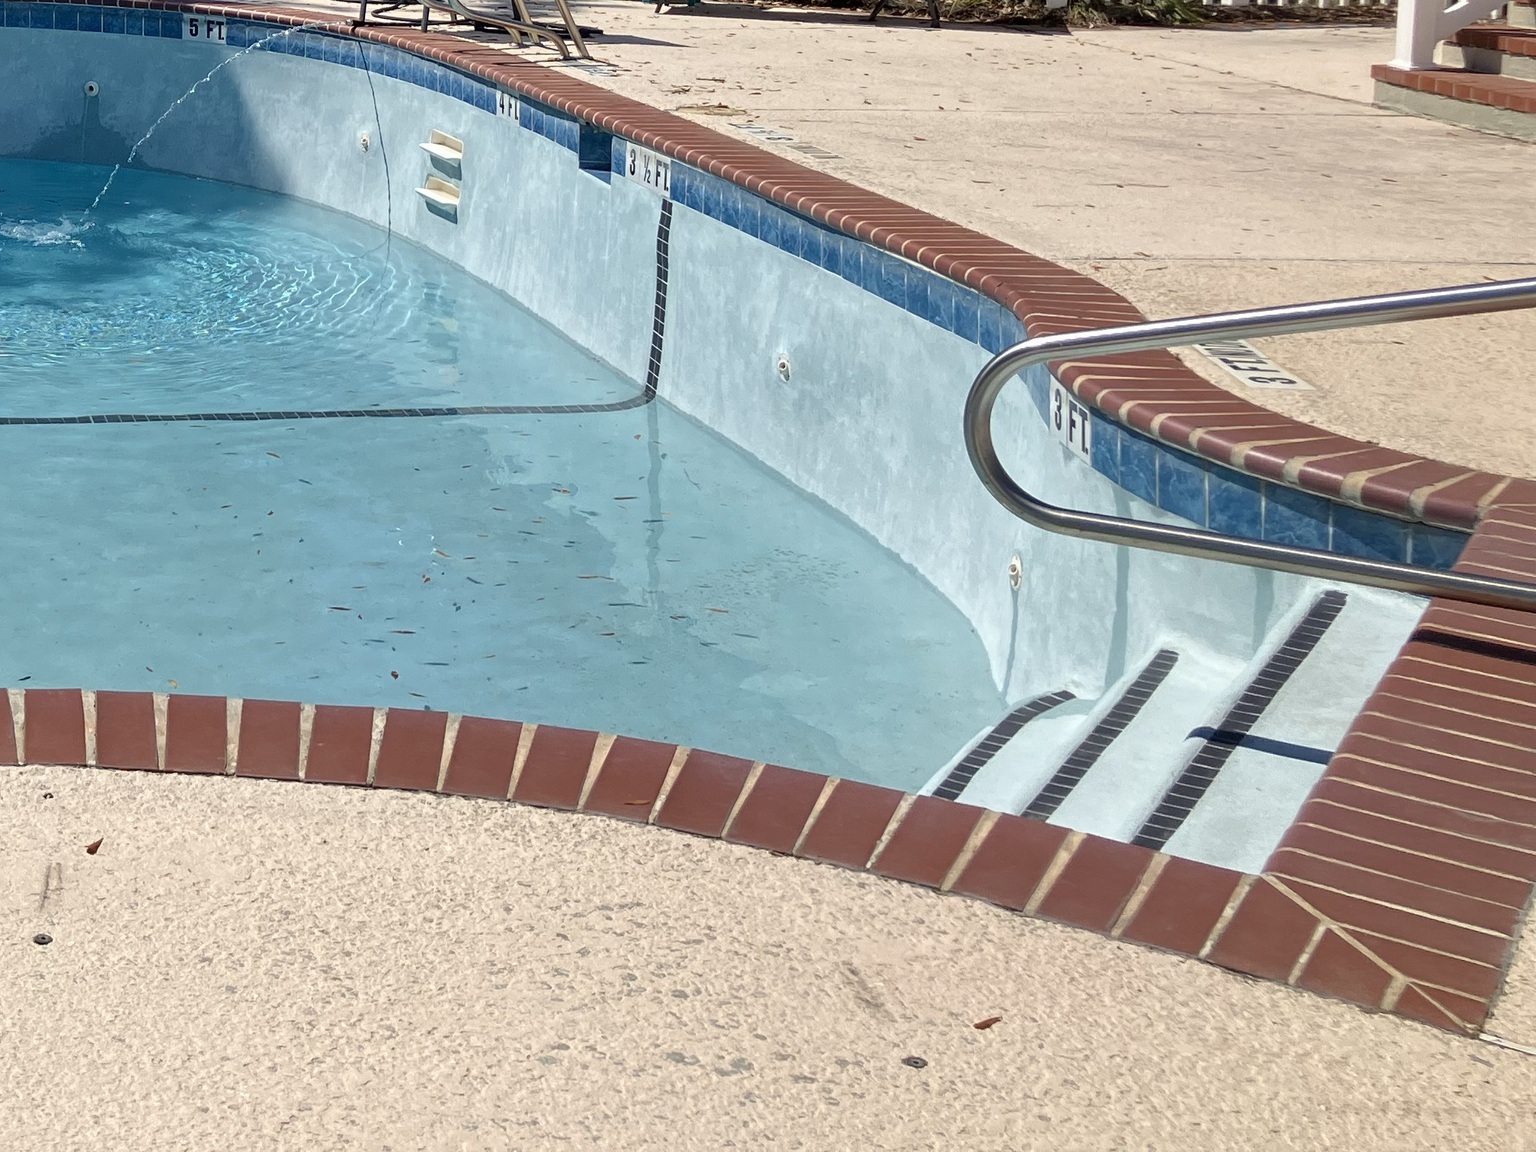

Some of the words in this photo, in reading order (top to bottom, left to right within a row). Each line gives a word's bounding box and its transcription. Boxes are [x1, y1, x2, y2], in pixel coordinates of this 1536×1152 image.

[189, 17, 199, 37] 5
[206, 19, 225, 41] FT.
[499, 93, 505, 114] 4
[629, 148, 636, 176] 3
[655, 159, 670, 192] FT.
[1054, 388, 1062, 431] 3
[1069, 399, 1089, 455] FT.
